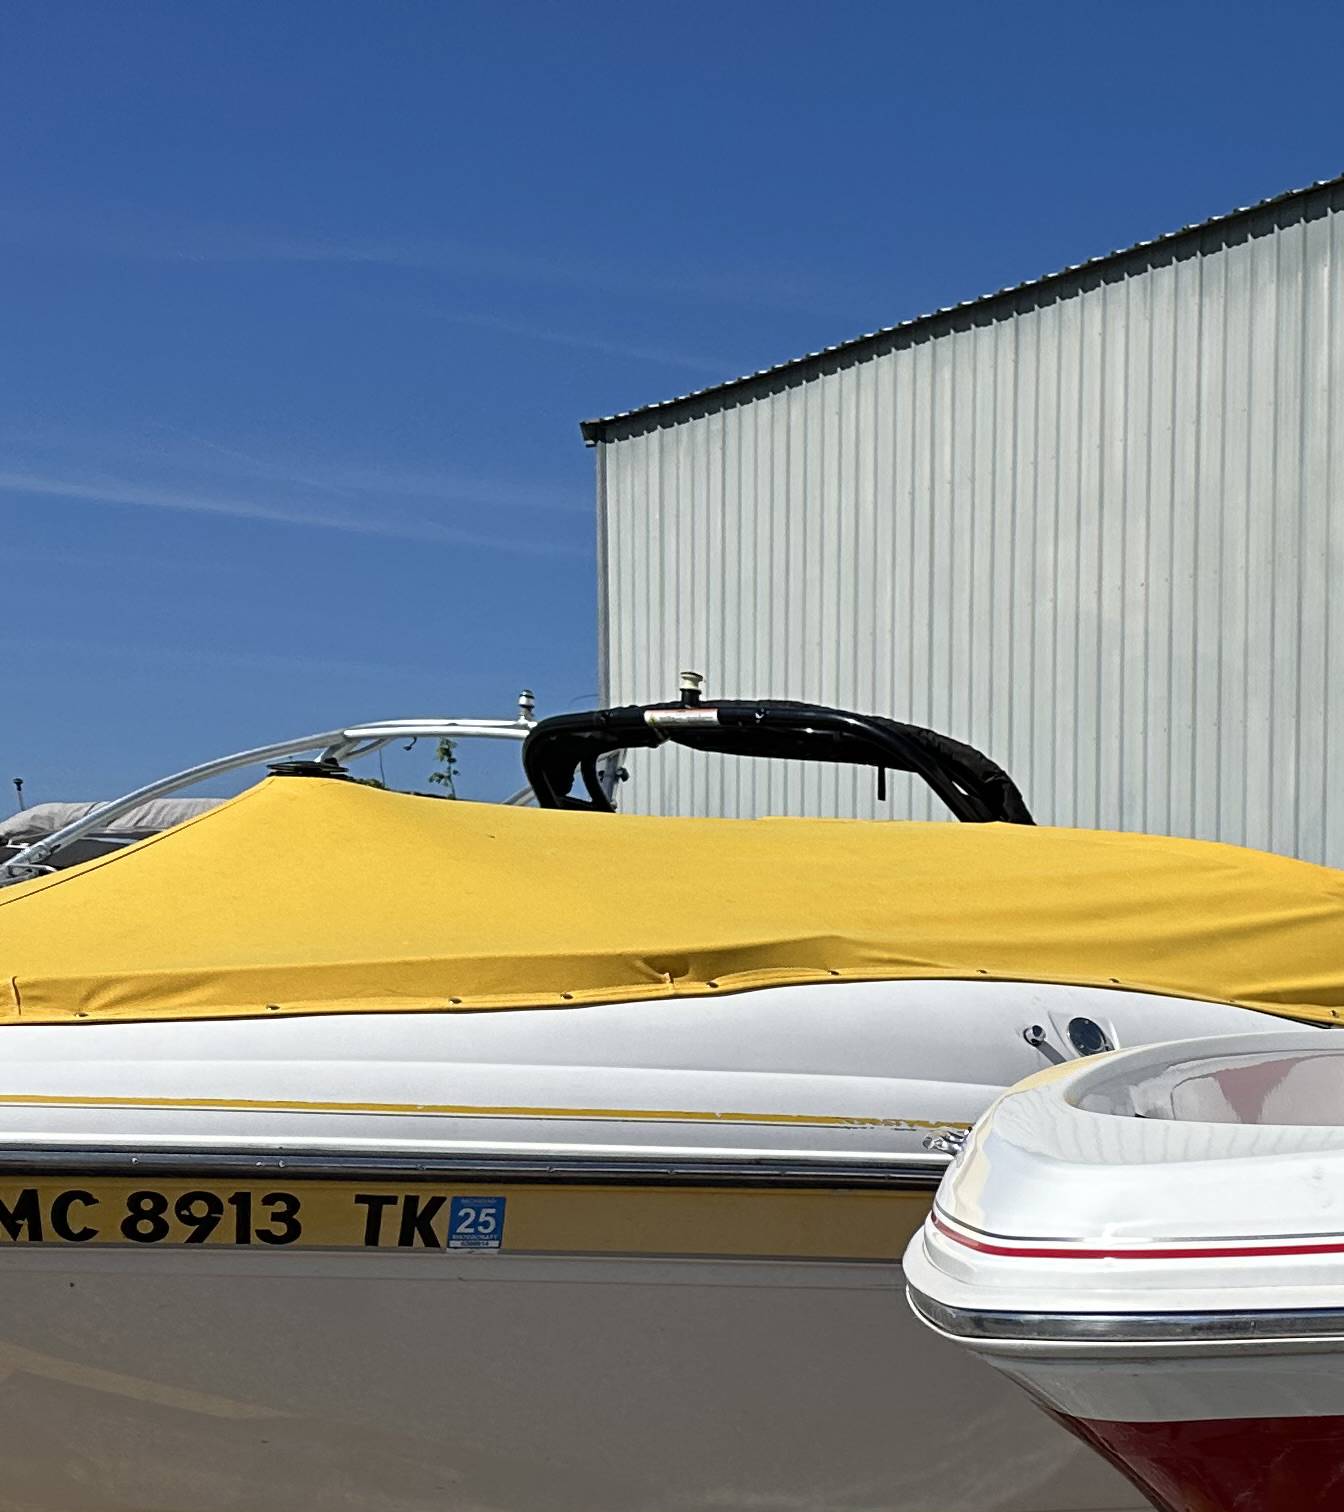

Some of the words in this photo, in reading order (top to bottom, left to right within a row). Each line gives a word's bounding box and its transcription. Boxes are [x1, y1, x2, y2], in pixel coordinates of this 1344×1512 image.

[0, 1189, 99, 1242] MC
[120, 1190, 302, 1245] 8913
[354, 1194, 447, 1249] TK
[456, 1207, 497, 1234] 25
